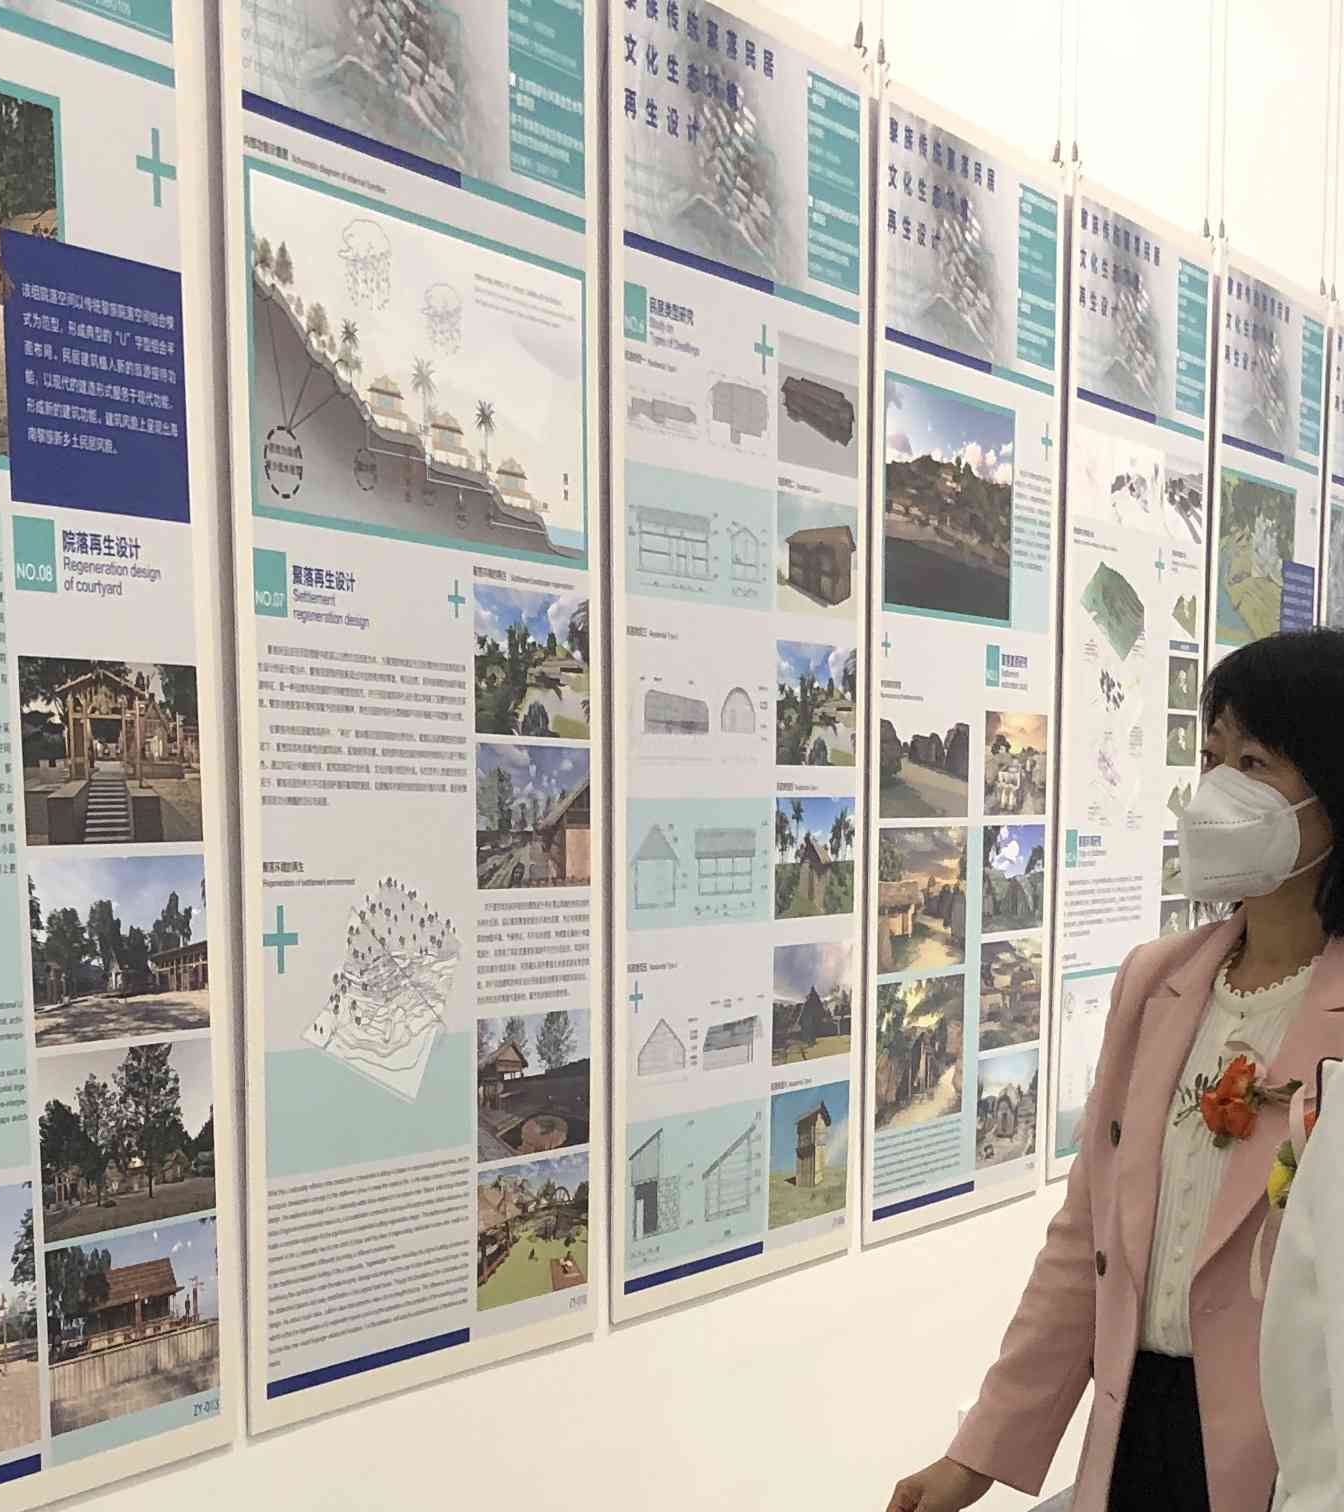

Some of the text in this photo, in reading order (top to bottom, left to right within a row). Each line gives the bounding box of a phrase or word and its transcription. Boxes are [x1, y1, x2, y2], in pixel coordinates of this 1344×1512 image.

[62, 530, 141, 560] 院落再生设计
[64, 557, 161, 582] Regeneration design
[292, 565, 356, 592] 聚落再生设计
[64, 577, 123, 598] of courtyard
